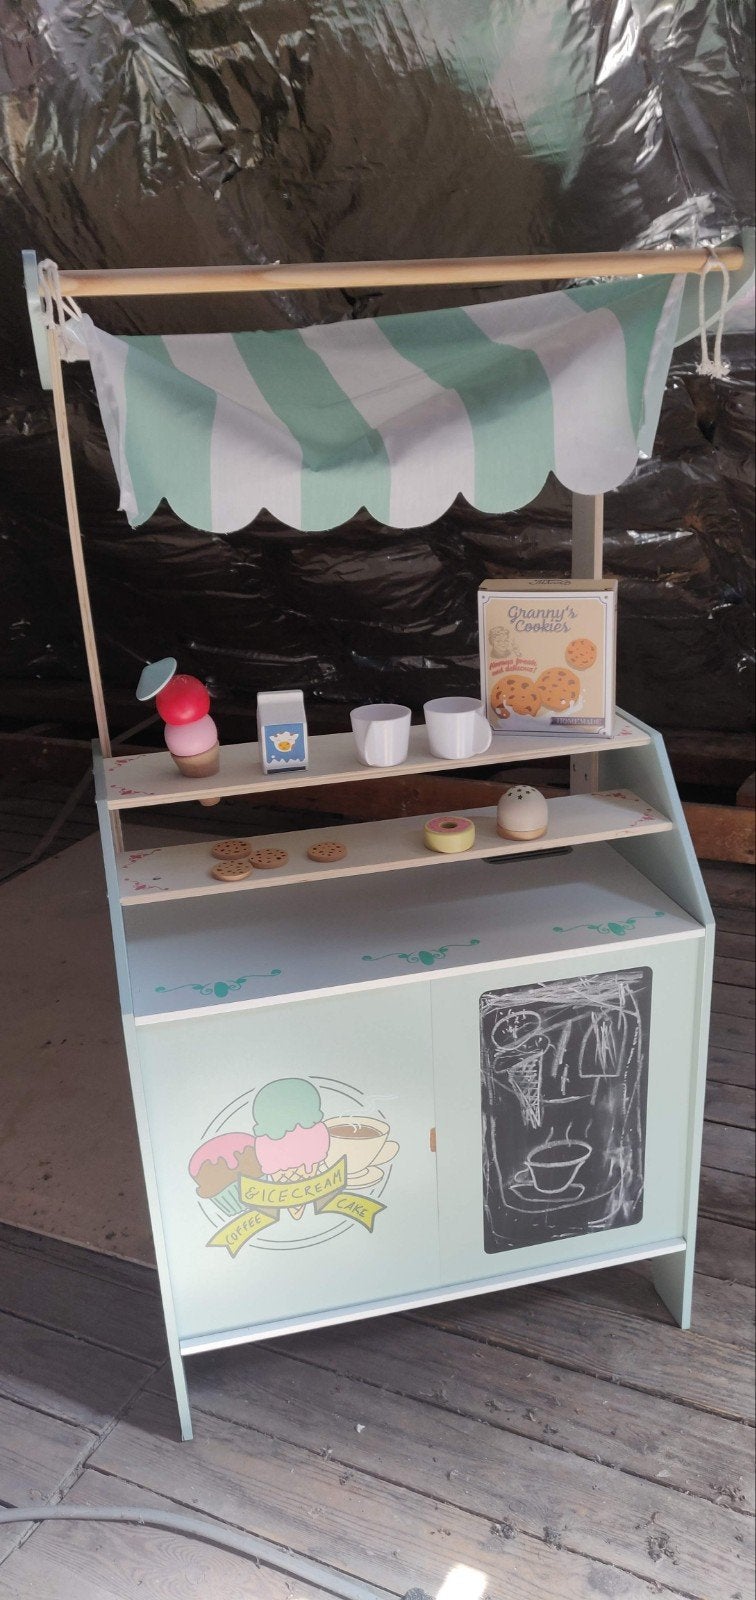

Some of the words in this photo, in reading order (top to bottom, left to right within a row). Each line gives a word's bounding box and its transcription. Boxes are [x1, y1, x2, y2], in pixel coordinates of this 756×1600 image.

[508, 605, 577, 623] Granny's
[514, 619, 571, 633] Cookies
[336, 1197, 368, 1219] CAKE
[225, 1213, 262, 1246] COFFEE
